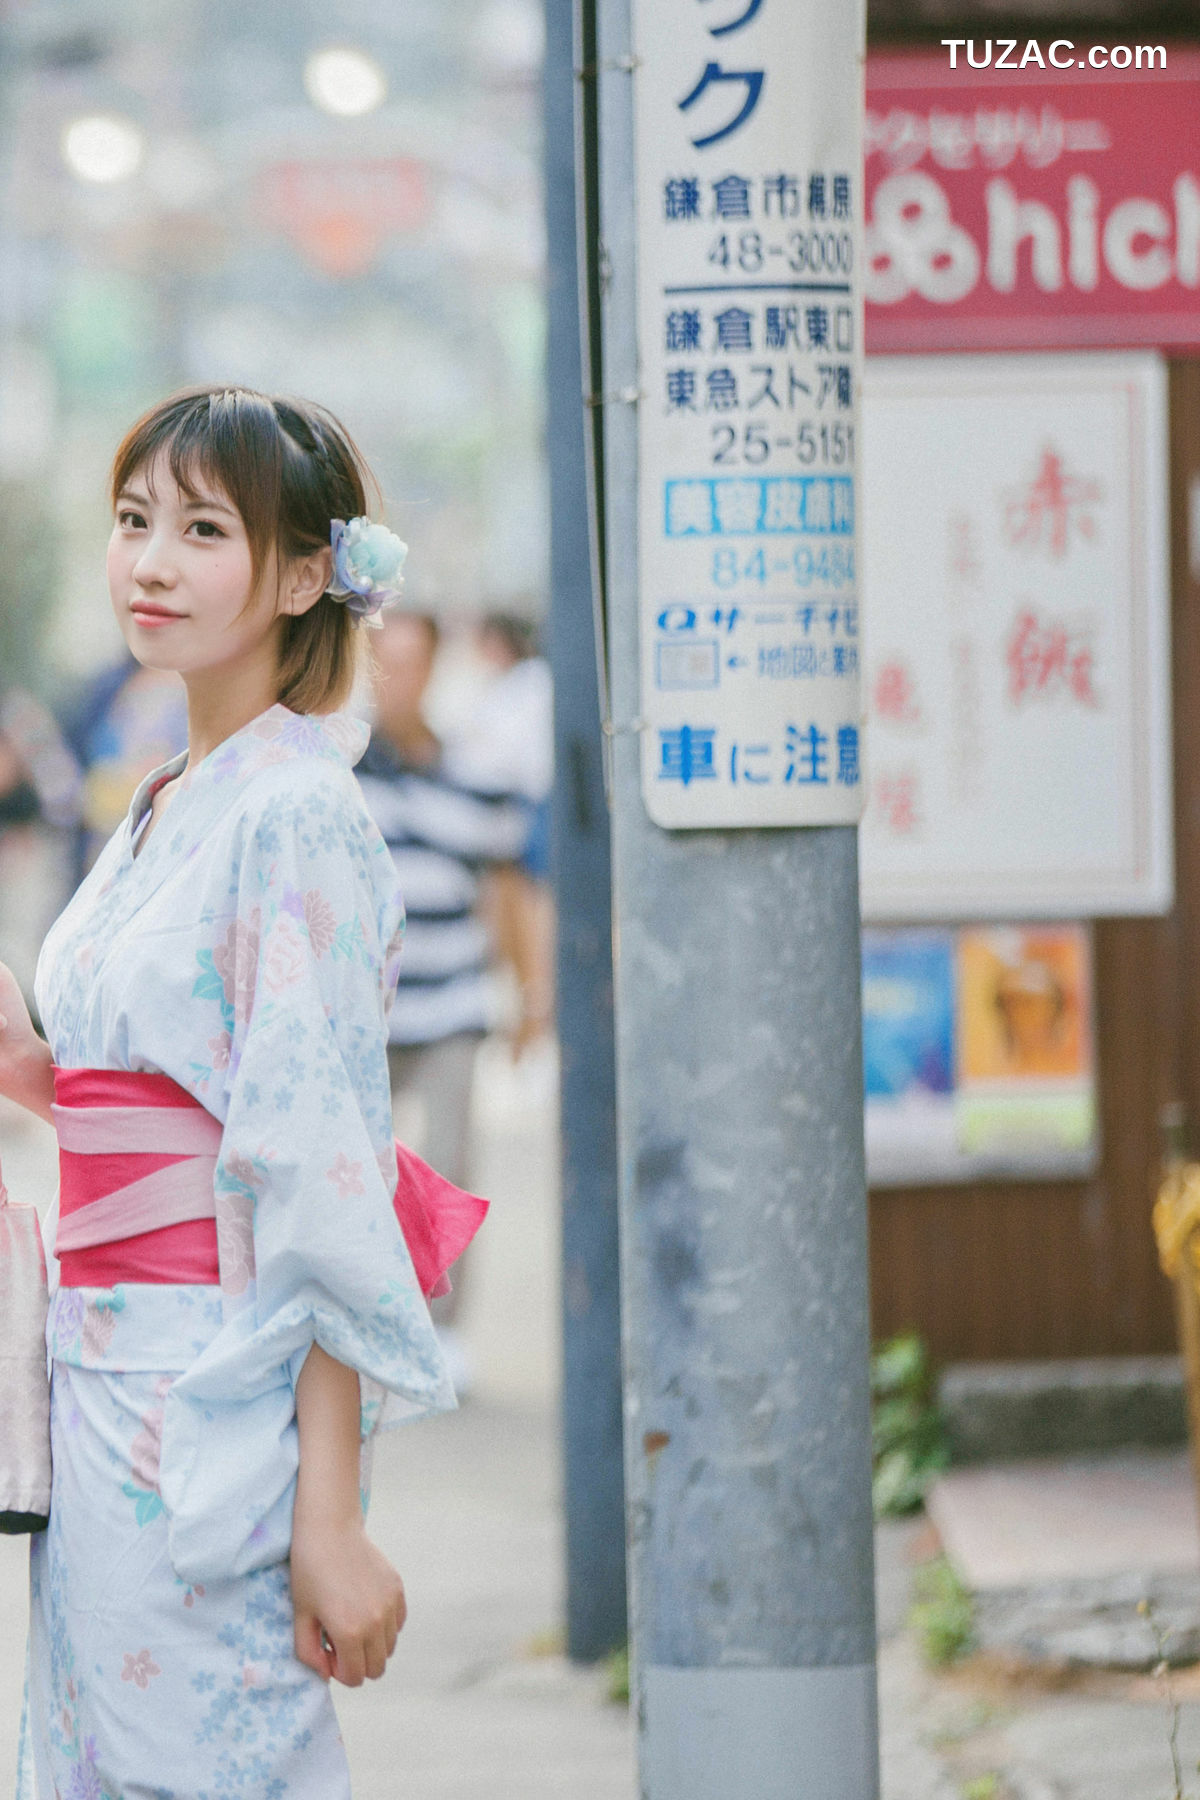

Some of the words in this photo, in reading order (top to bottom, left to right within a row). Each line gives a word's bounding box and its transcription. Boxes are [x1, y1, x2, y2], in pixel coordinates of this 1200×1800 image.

[709, 231, 852, 273] 48-3000
[665, 306, 852, 352] 鎌倉駅東口
[658, 724, 859, 786] 車に注意
